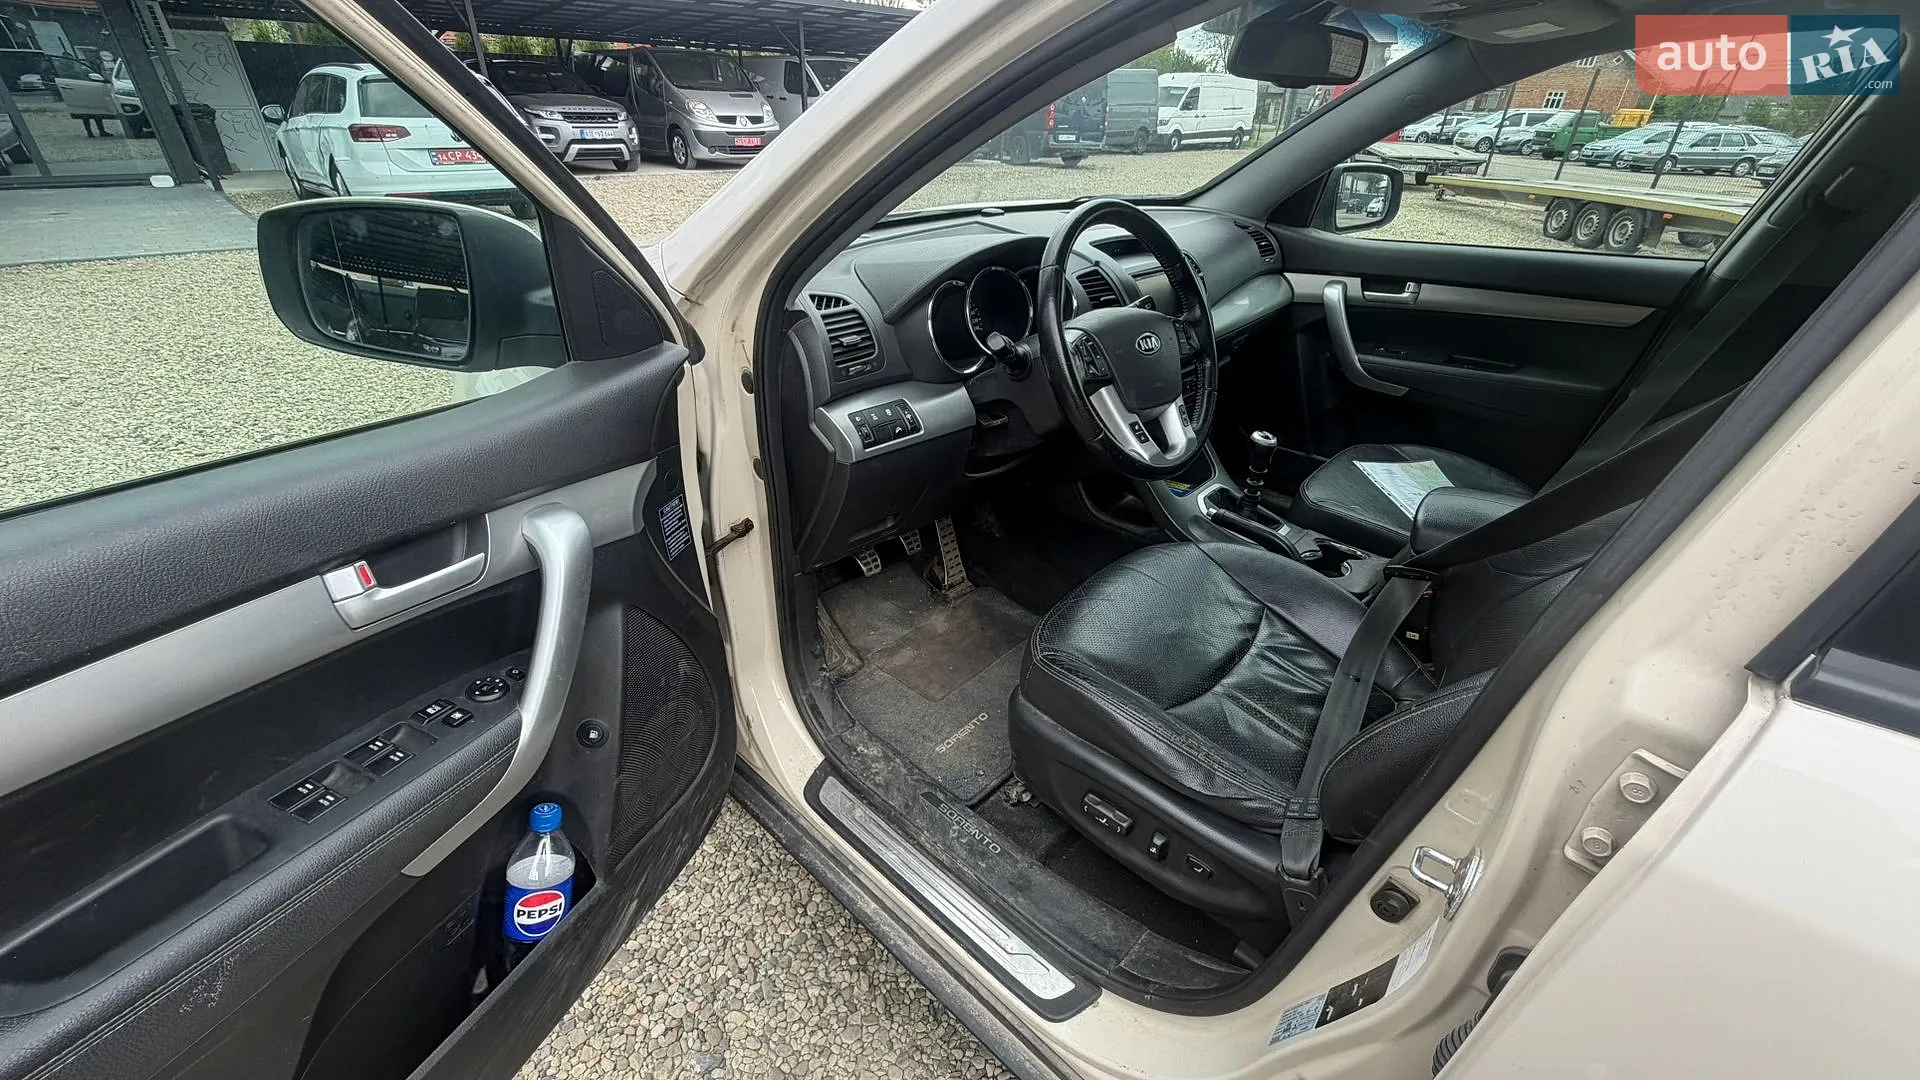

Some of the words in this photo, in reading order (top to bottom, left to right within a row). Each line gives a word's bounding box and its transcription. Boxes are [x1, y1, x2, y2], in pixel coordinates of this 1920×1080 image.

[1139, 336, 1159, 351] KIA
[935, 712, 989, 754] SORENTO
[938, 803, 1002, 854] SORENTO
[516, 902, 563, 919] PEPSI
